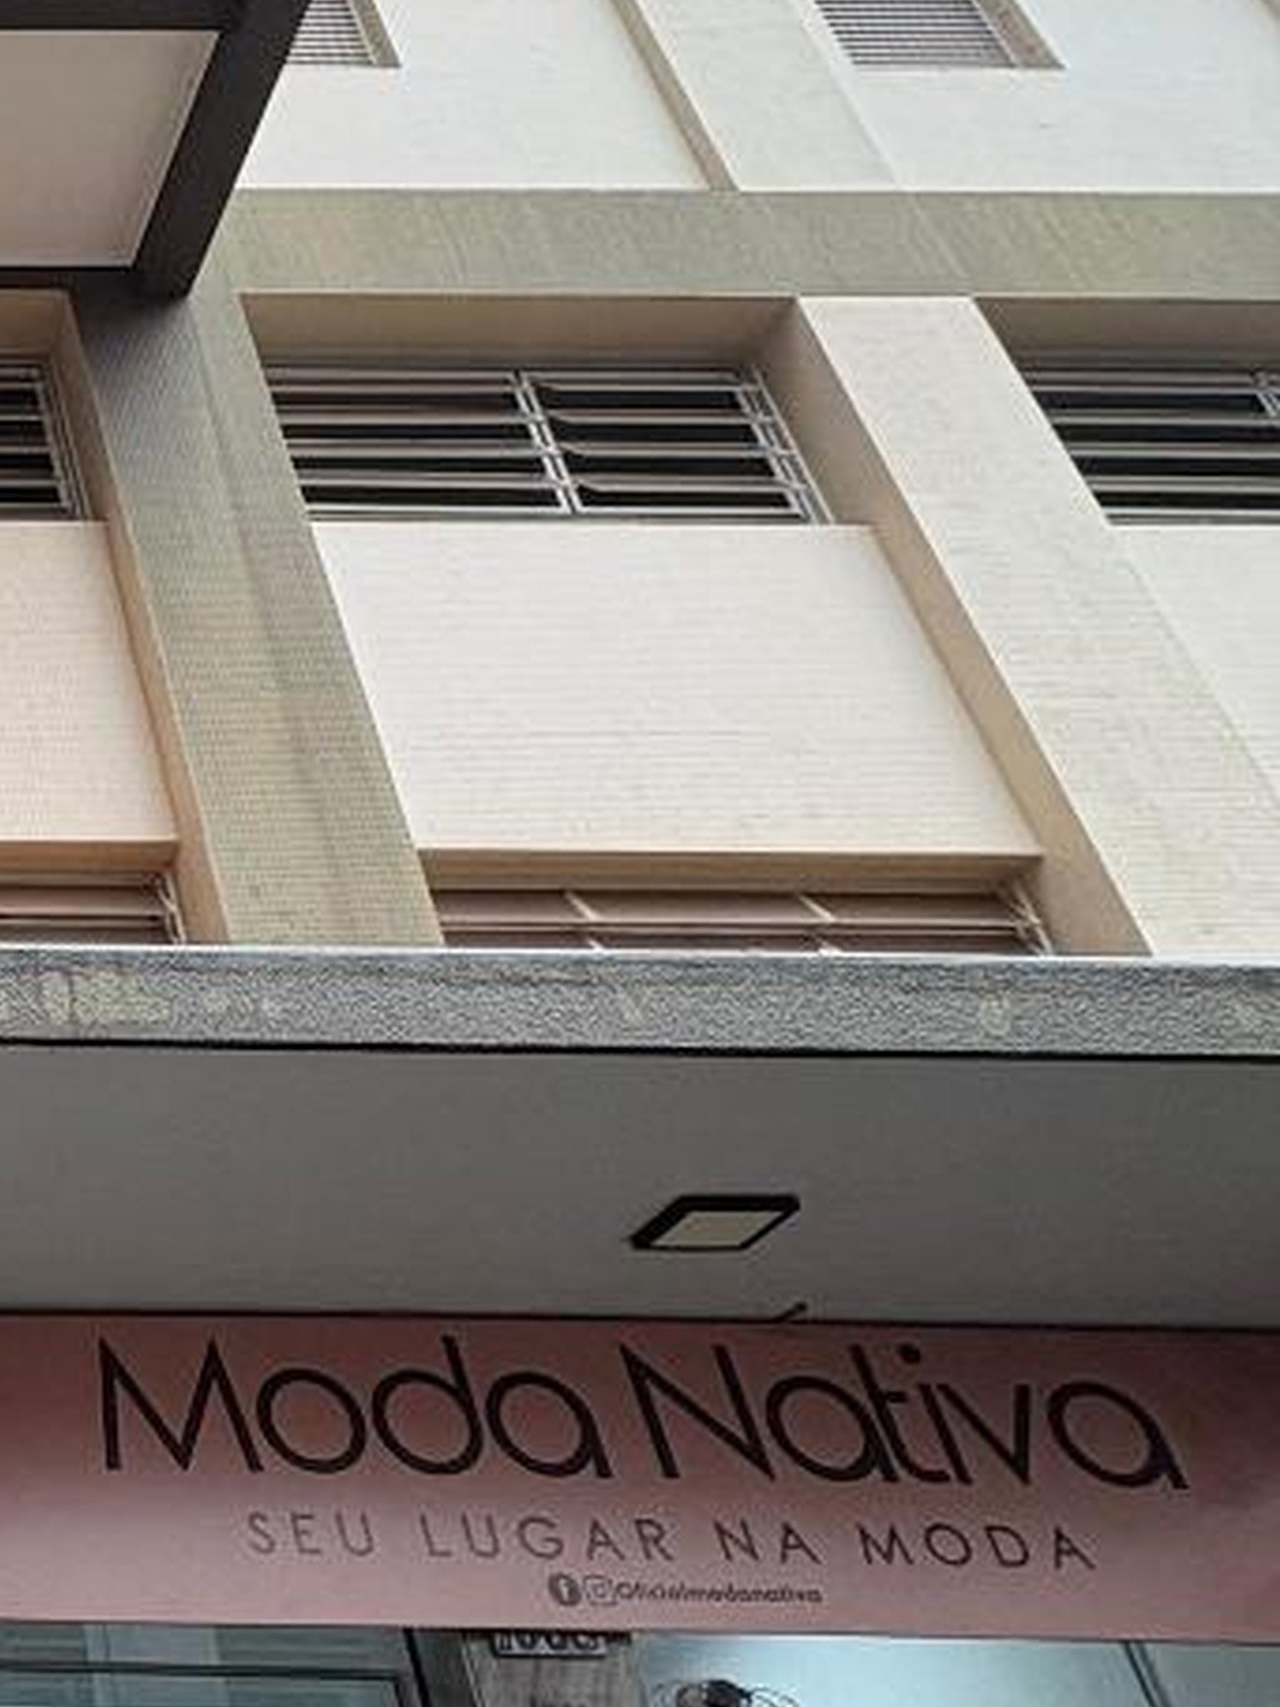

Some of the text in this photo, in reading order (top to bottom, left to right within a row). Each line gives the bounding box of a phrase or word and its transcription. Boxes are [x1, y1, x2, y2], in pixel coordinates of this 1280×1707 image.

[97, 1334, 1190, 1490] Moda Nativa
[246, 1510, 1096, 1571] SEU LUGAR NA MODA
